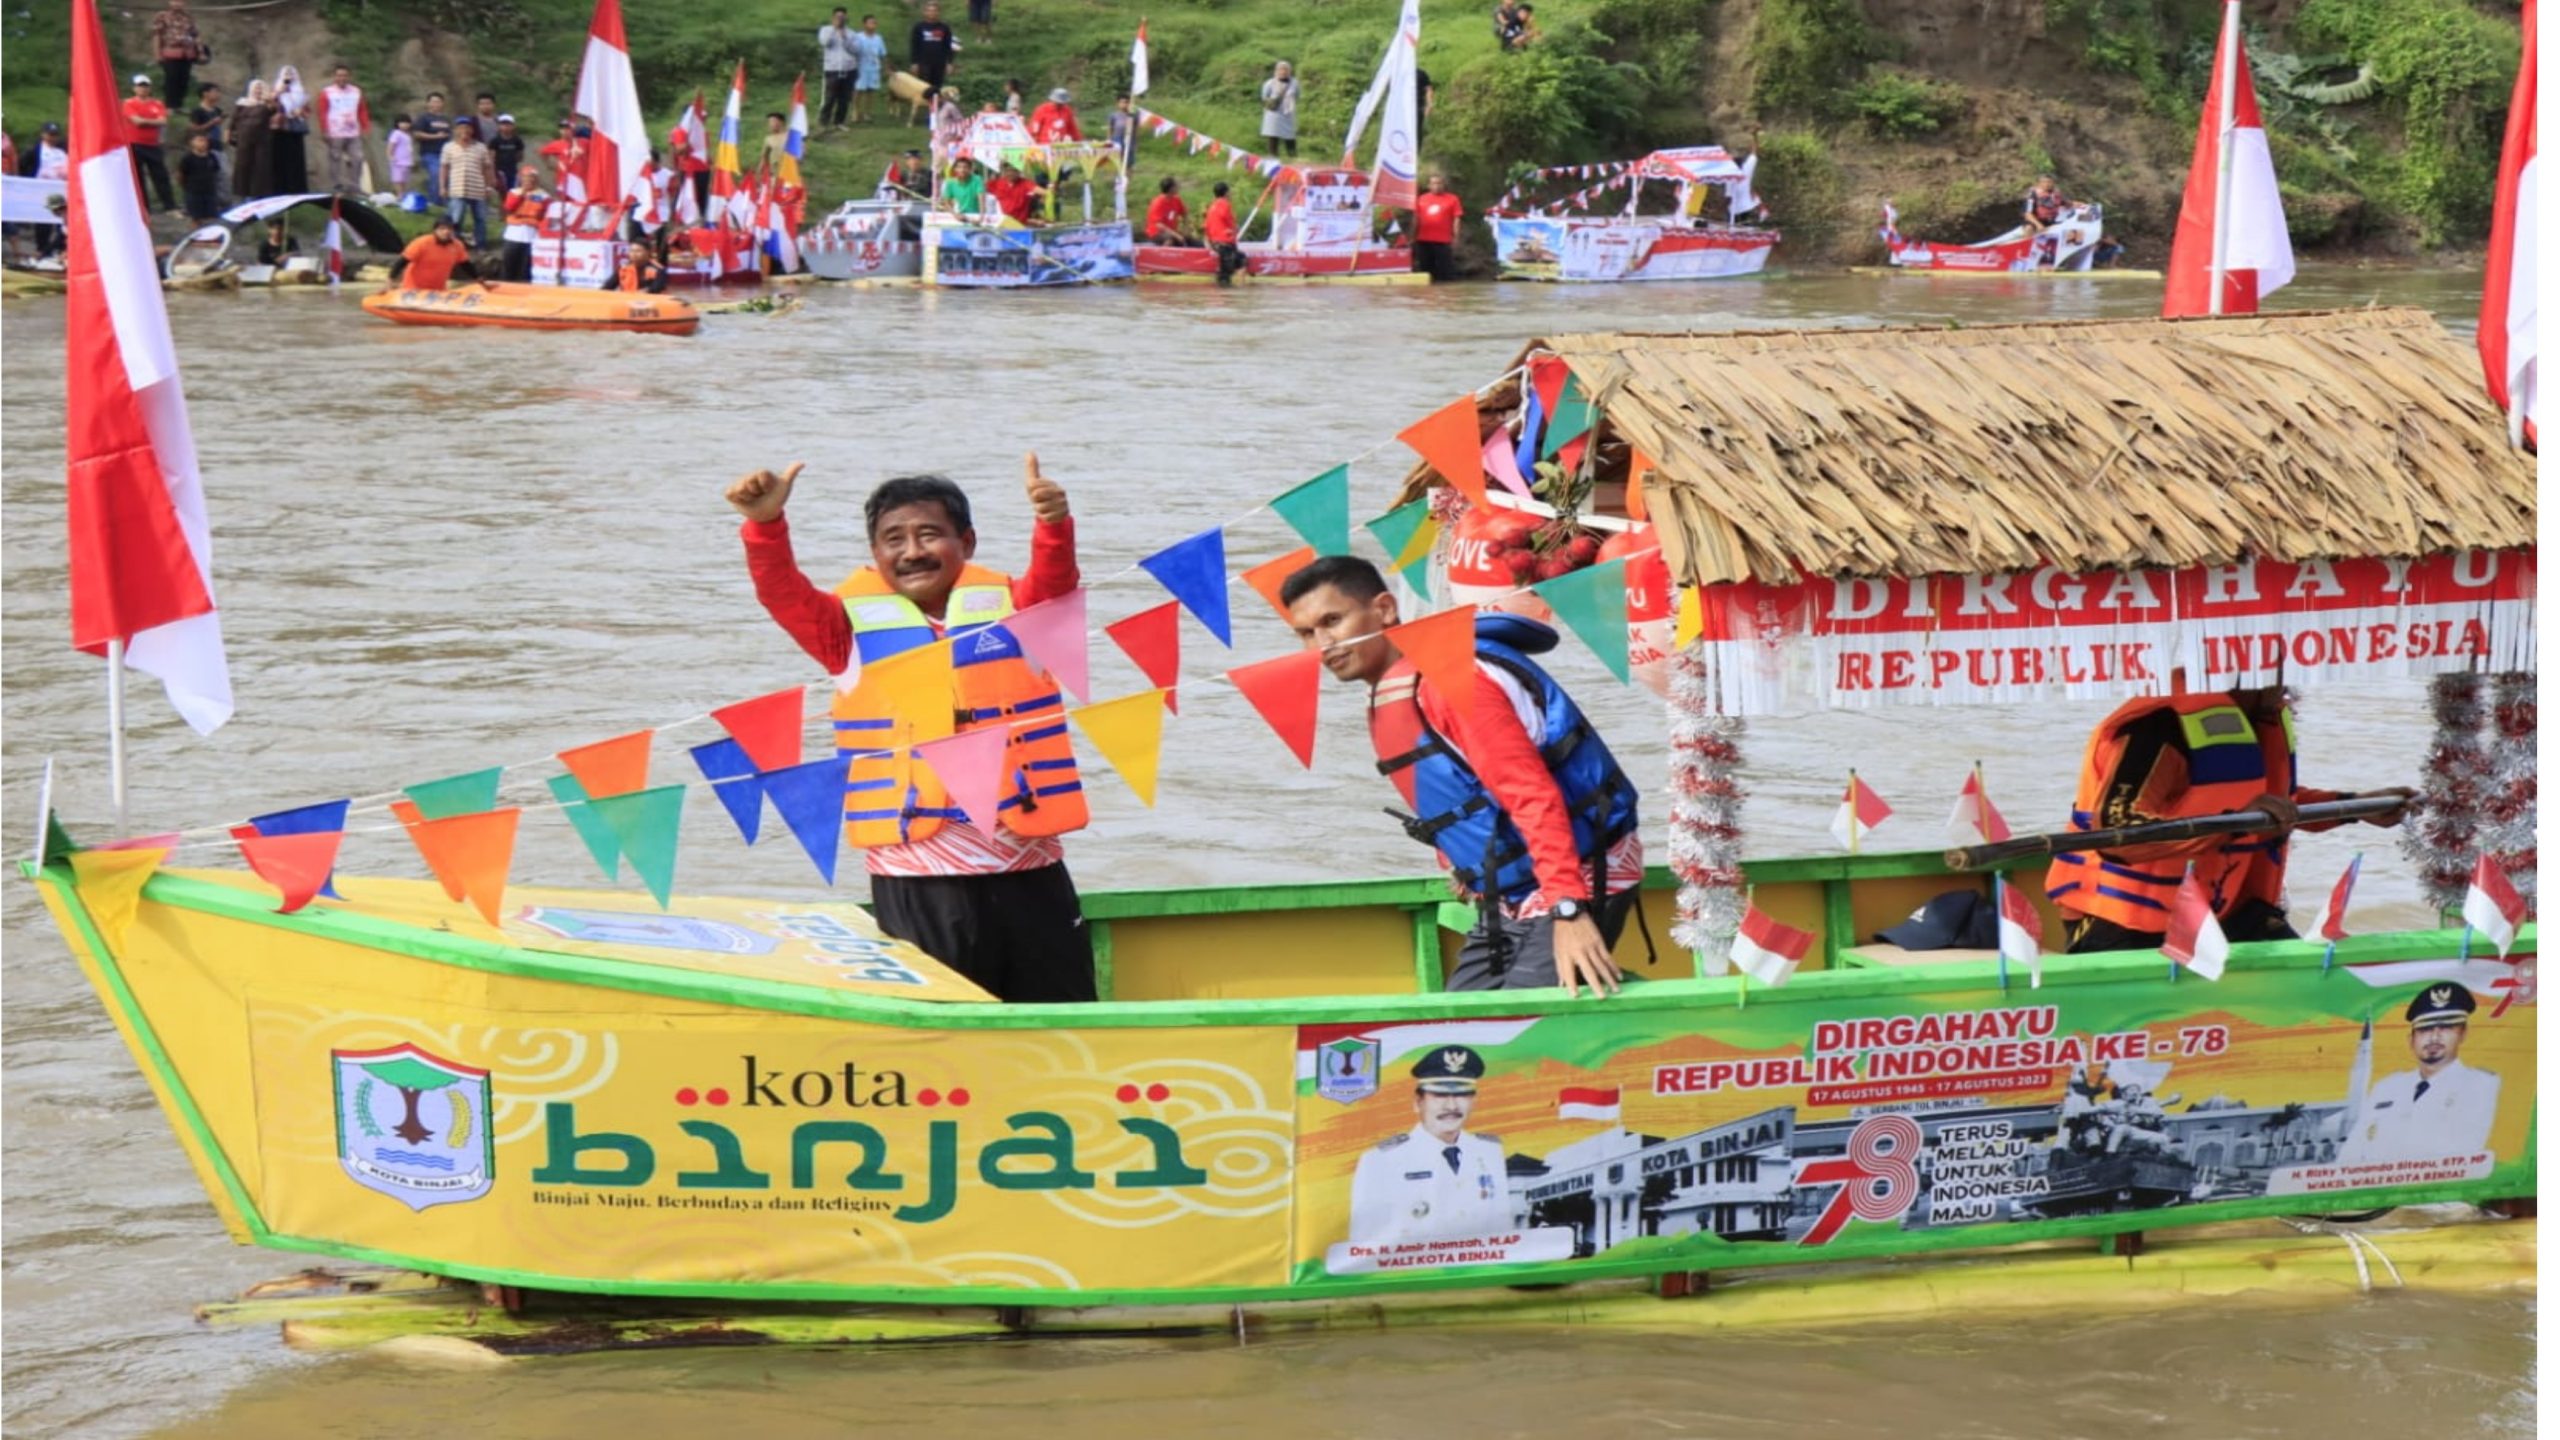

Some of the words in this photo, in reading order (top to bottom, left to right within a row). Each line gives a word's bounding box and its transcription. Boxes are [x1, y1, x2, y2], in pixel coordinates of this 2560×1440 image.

[1450, 538, 1493, 572] OVE
[1836, 642, 2156, 690] REPUBLIK
[2203, 619, 2491, 674] INDONESIA
[1816, 1008, 2056, 1052] DIRGAHAYU
[1656, 1055, 1858, 1093] REPUBLIK
[1868, 1038, 2082, 1078] INDONESIA
[2094, 1034, 2147, 1061] KE
[2181, 1028, 2226, 1054] 78
[741, 1055, 910, 1108] kota
[1813, 1091, 1828, 1101] 17
[1832, 1087, 1892, 1100] AGUSTUS
[1896, 1083, 1924, 1094] 1945
[1938, 1081, 1951, 1092] 17
[1954, 1077, 2014, 1090] AGUSTUS
[2018, 1074, 2047, 1086] 2023
[1942, 1123, 2008, 1142] TERUS
[1642, 1147, 1690, 1174] KOTA
[1701, 1120, 1784, 1159] BINJAI
[1937, 1141, 2024, 1162] MELAJU
[369, 1167, 409, 1184] KOTA
[1796, 1114, 1922, 1246] 78
[1935, 1163, 2008, 1181] UNTUK
[2306, 1168, 2336, 1178] Rizky
[2341, 1163, 2394, 1174] Yunanda
[2307, 1181, 2346, 1190] WAKIL
[2351, 1177, 2384, 1186] WALI
[2386, 1174, 2420, 1183] KOTA
[2424, 1170, 2465, 1180] BINJAI
[533, 1191, 590, 1207] Binjai
[657, 1195, 763, 1212] Berbudaya
[768, 1197, 805, 1210] dan
[812, 1197, 891, 1212] Religius
[1934, 1178, 2047, 1203] INDONESIA
[1932, 1203, 1992, 1221] MAJU
[1350, 1246, 1376, 1257] Drs.
[1395, 1243, 1425, 1253] Amir
[1489, 1235, 1521, 1246] M.AP
[1377, 1256, 1414, 1267] WALI
[1417, 1253, 1455, 1265] KOTA
[1458, 1250, 1505, 1262] BINJAI
